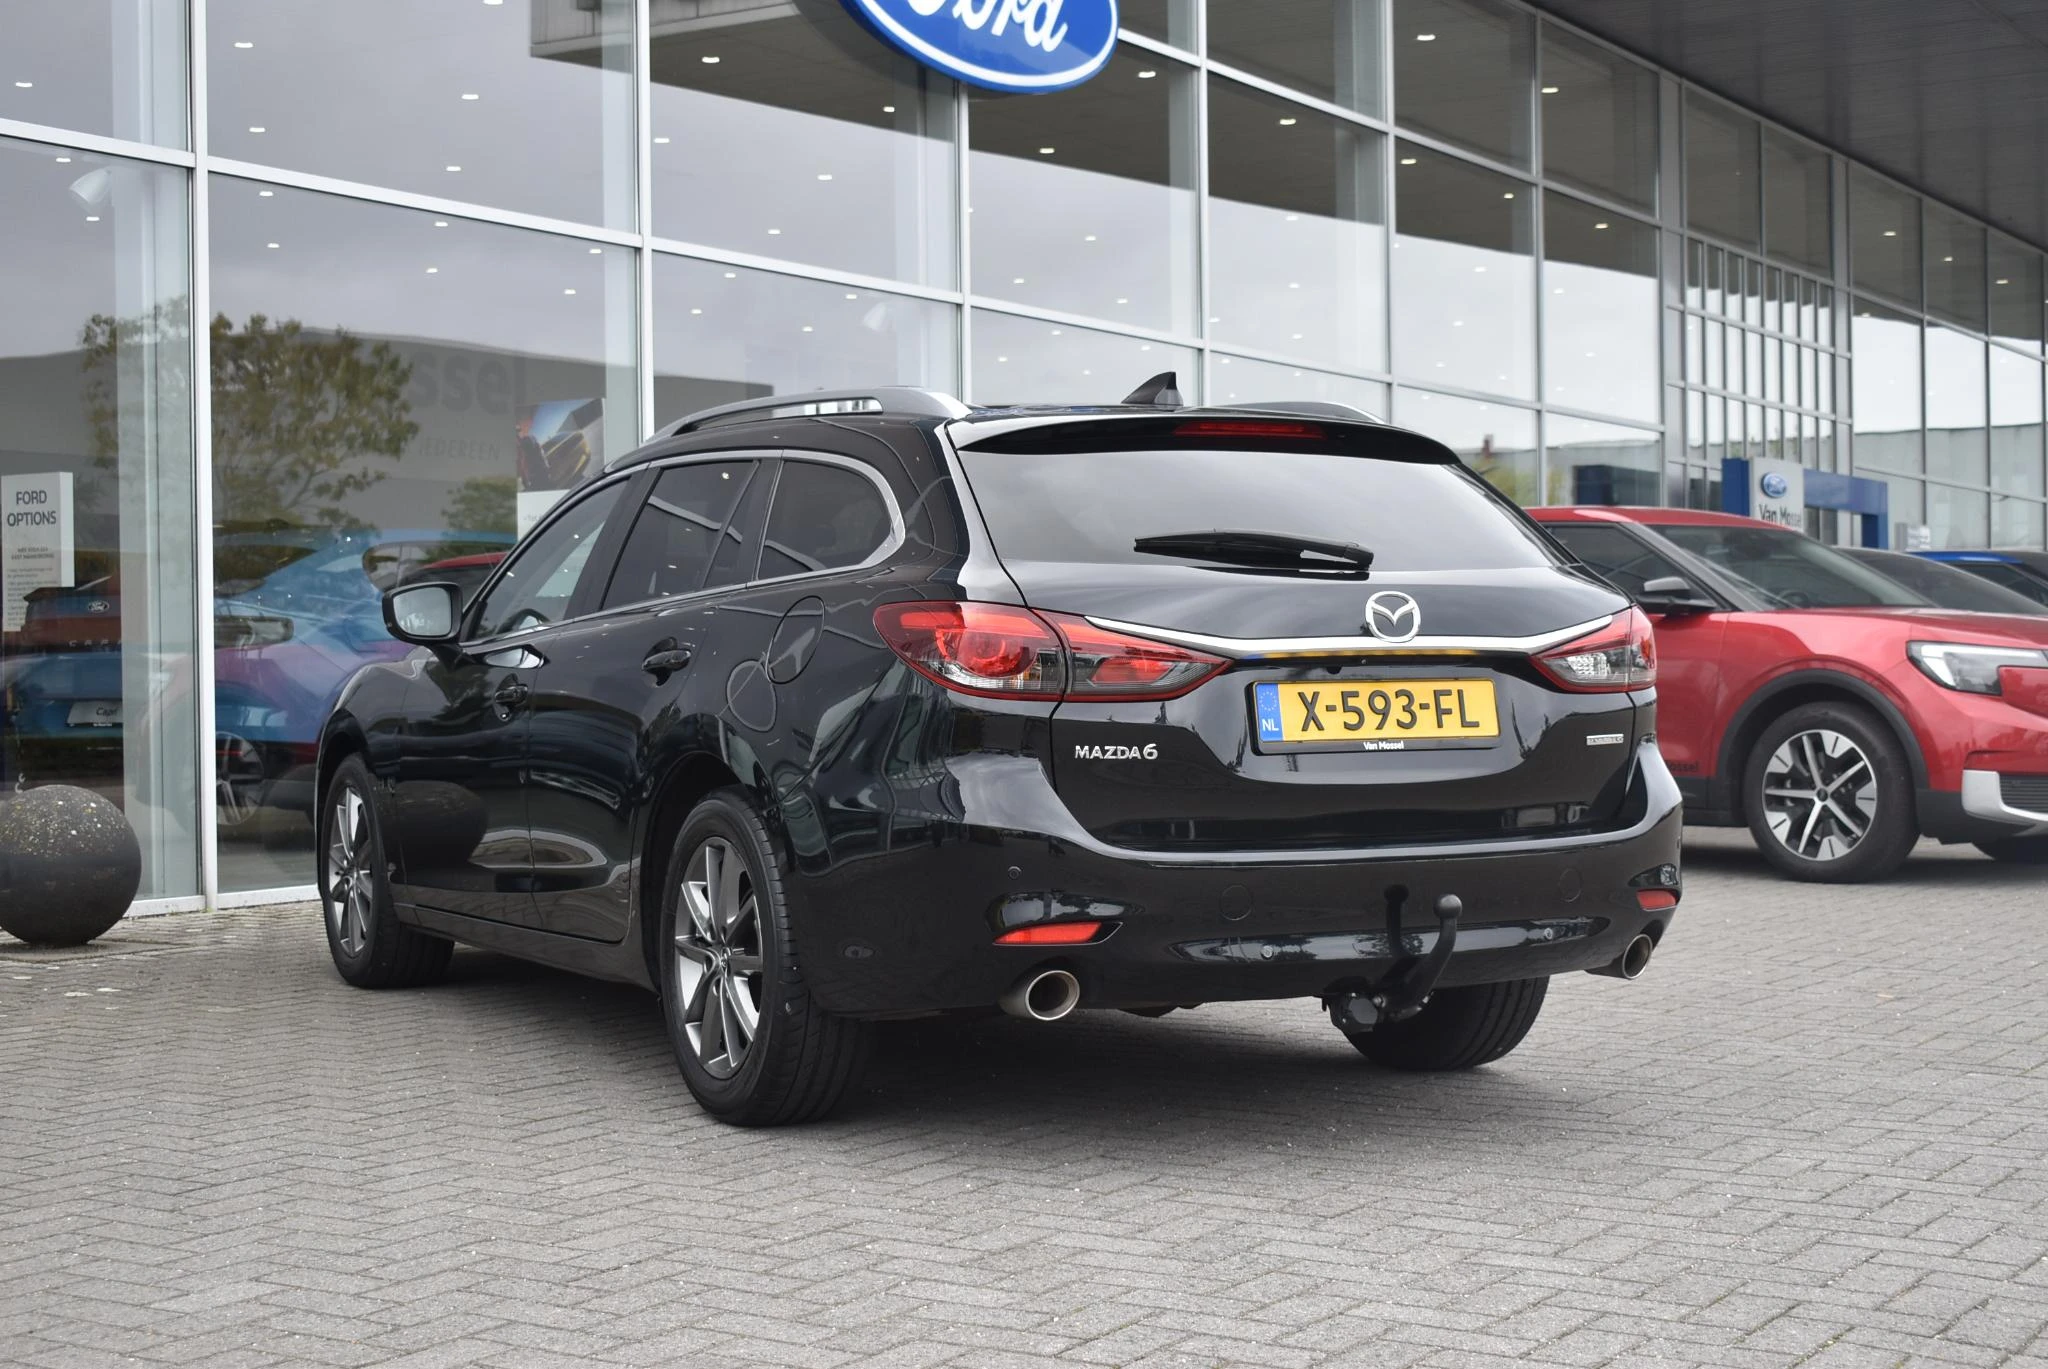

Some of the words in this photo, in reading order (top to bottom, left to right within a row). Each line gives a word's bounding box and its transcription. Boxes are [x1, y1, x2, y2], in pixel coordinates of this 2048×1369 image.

[907, 0, 1067, 52] ord
[15, 490, 48, 505] FORD
[7, 511, 57, 527] OPTIONS
[1759, 503, 1777, 523] Van
[1297, 688, 1480, 732] X-593-FL
[1262, 719, 1280, 732] NL
[1363, 741, 1378, 750] Van
[1378, 740, 1405, 750] Mossel
[1666, 760, 1699, 773] ossel
